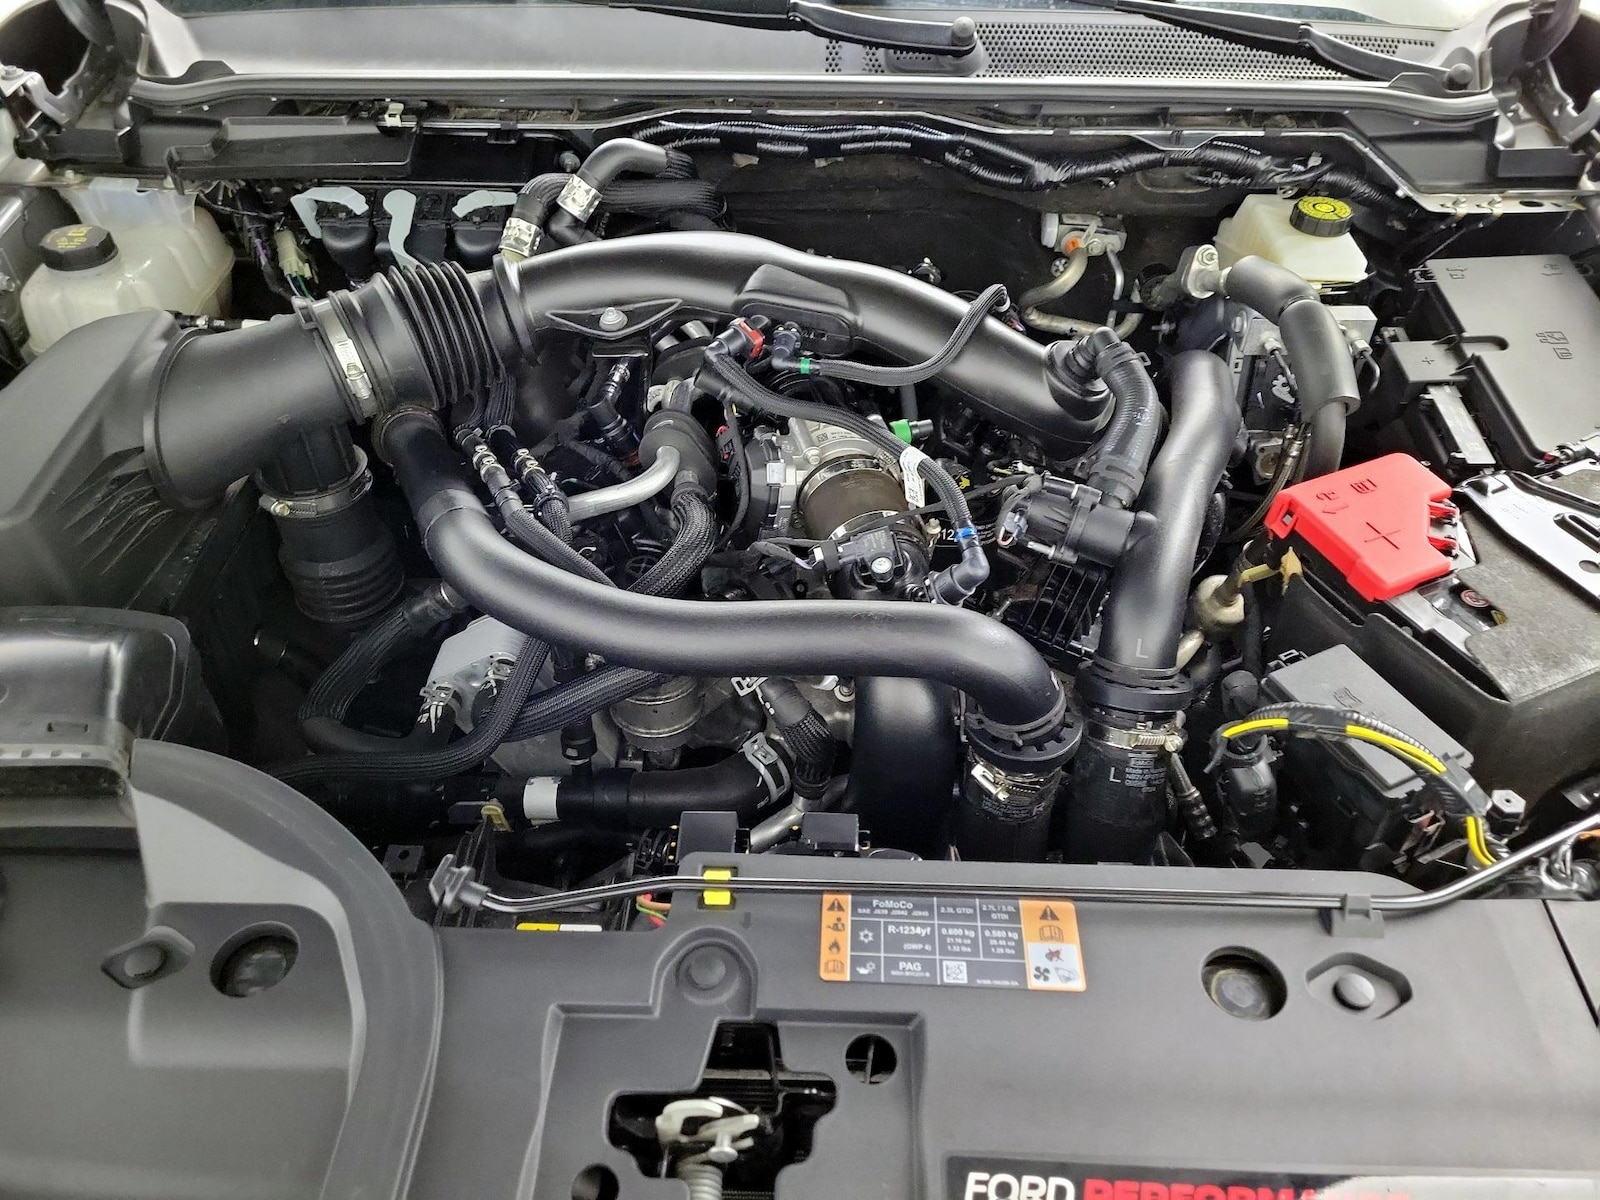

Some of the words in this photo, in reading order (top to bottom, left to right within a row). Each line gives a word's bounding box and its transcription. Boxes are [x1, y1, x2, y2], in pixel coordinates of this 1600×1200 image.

[1135, 638, 1149, 659] L
[1109, 766, 1121, 783] L
[872, 899, 914, 910] FoMoCo
[887, 924, 931, 937] R-1234yf
[964, 928, 976, 938] kg
[1007, 930, 1019, 940] kg
[898, 961, 922, 972] PAG
[964, 1171, 1076, 1200] FORD
